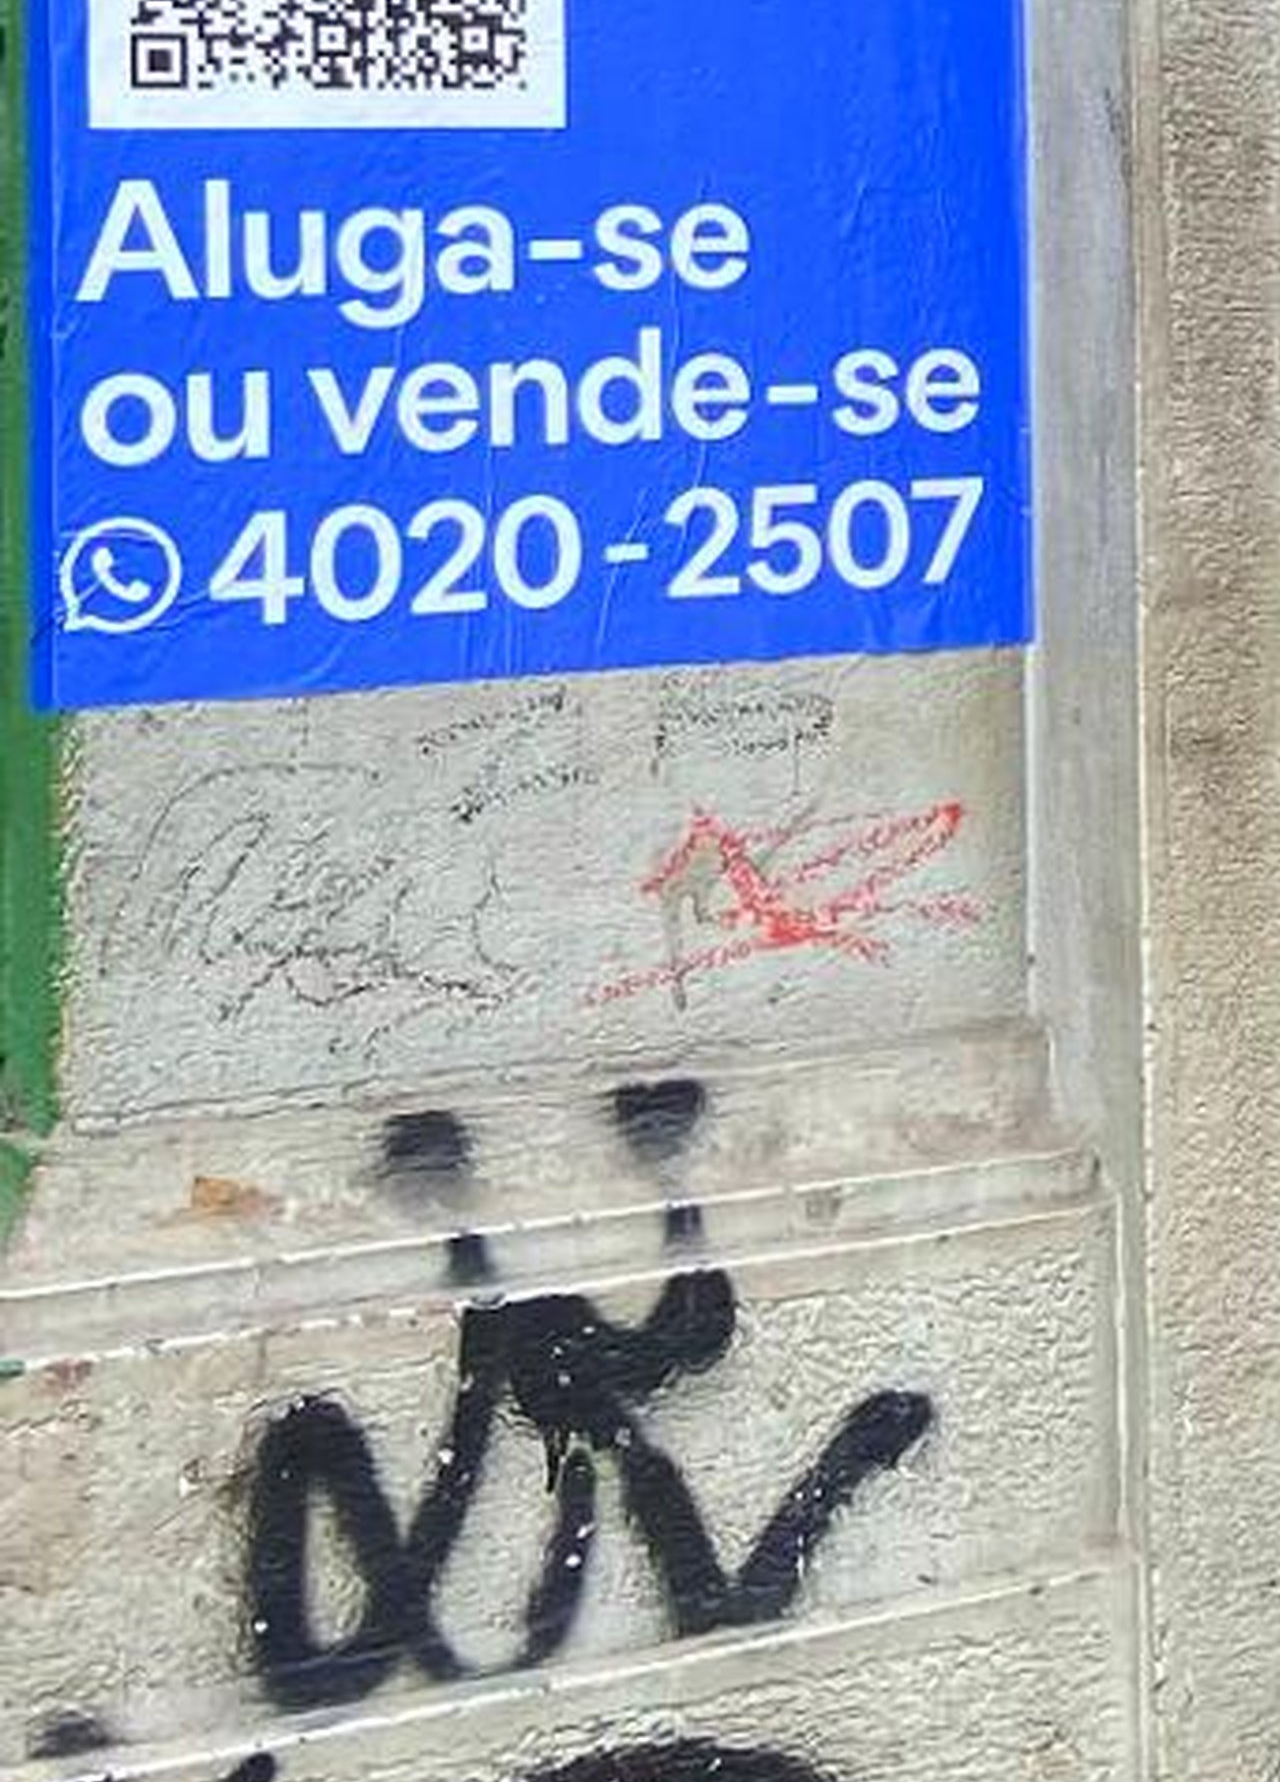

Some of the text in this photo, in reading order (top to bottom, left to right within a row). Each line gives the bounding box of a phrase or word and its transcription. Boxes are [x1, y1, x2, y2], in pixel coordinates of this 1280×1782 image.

[76, 179, 750, 328] Aluga-se
[80, 327, 982, 467] ou vende-se
[208, 476, 986, 625] 4020-2507
